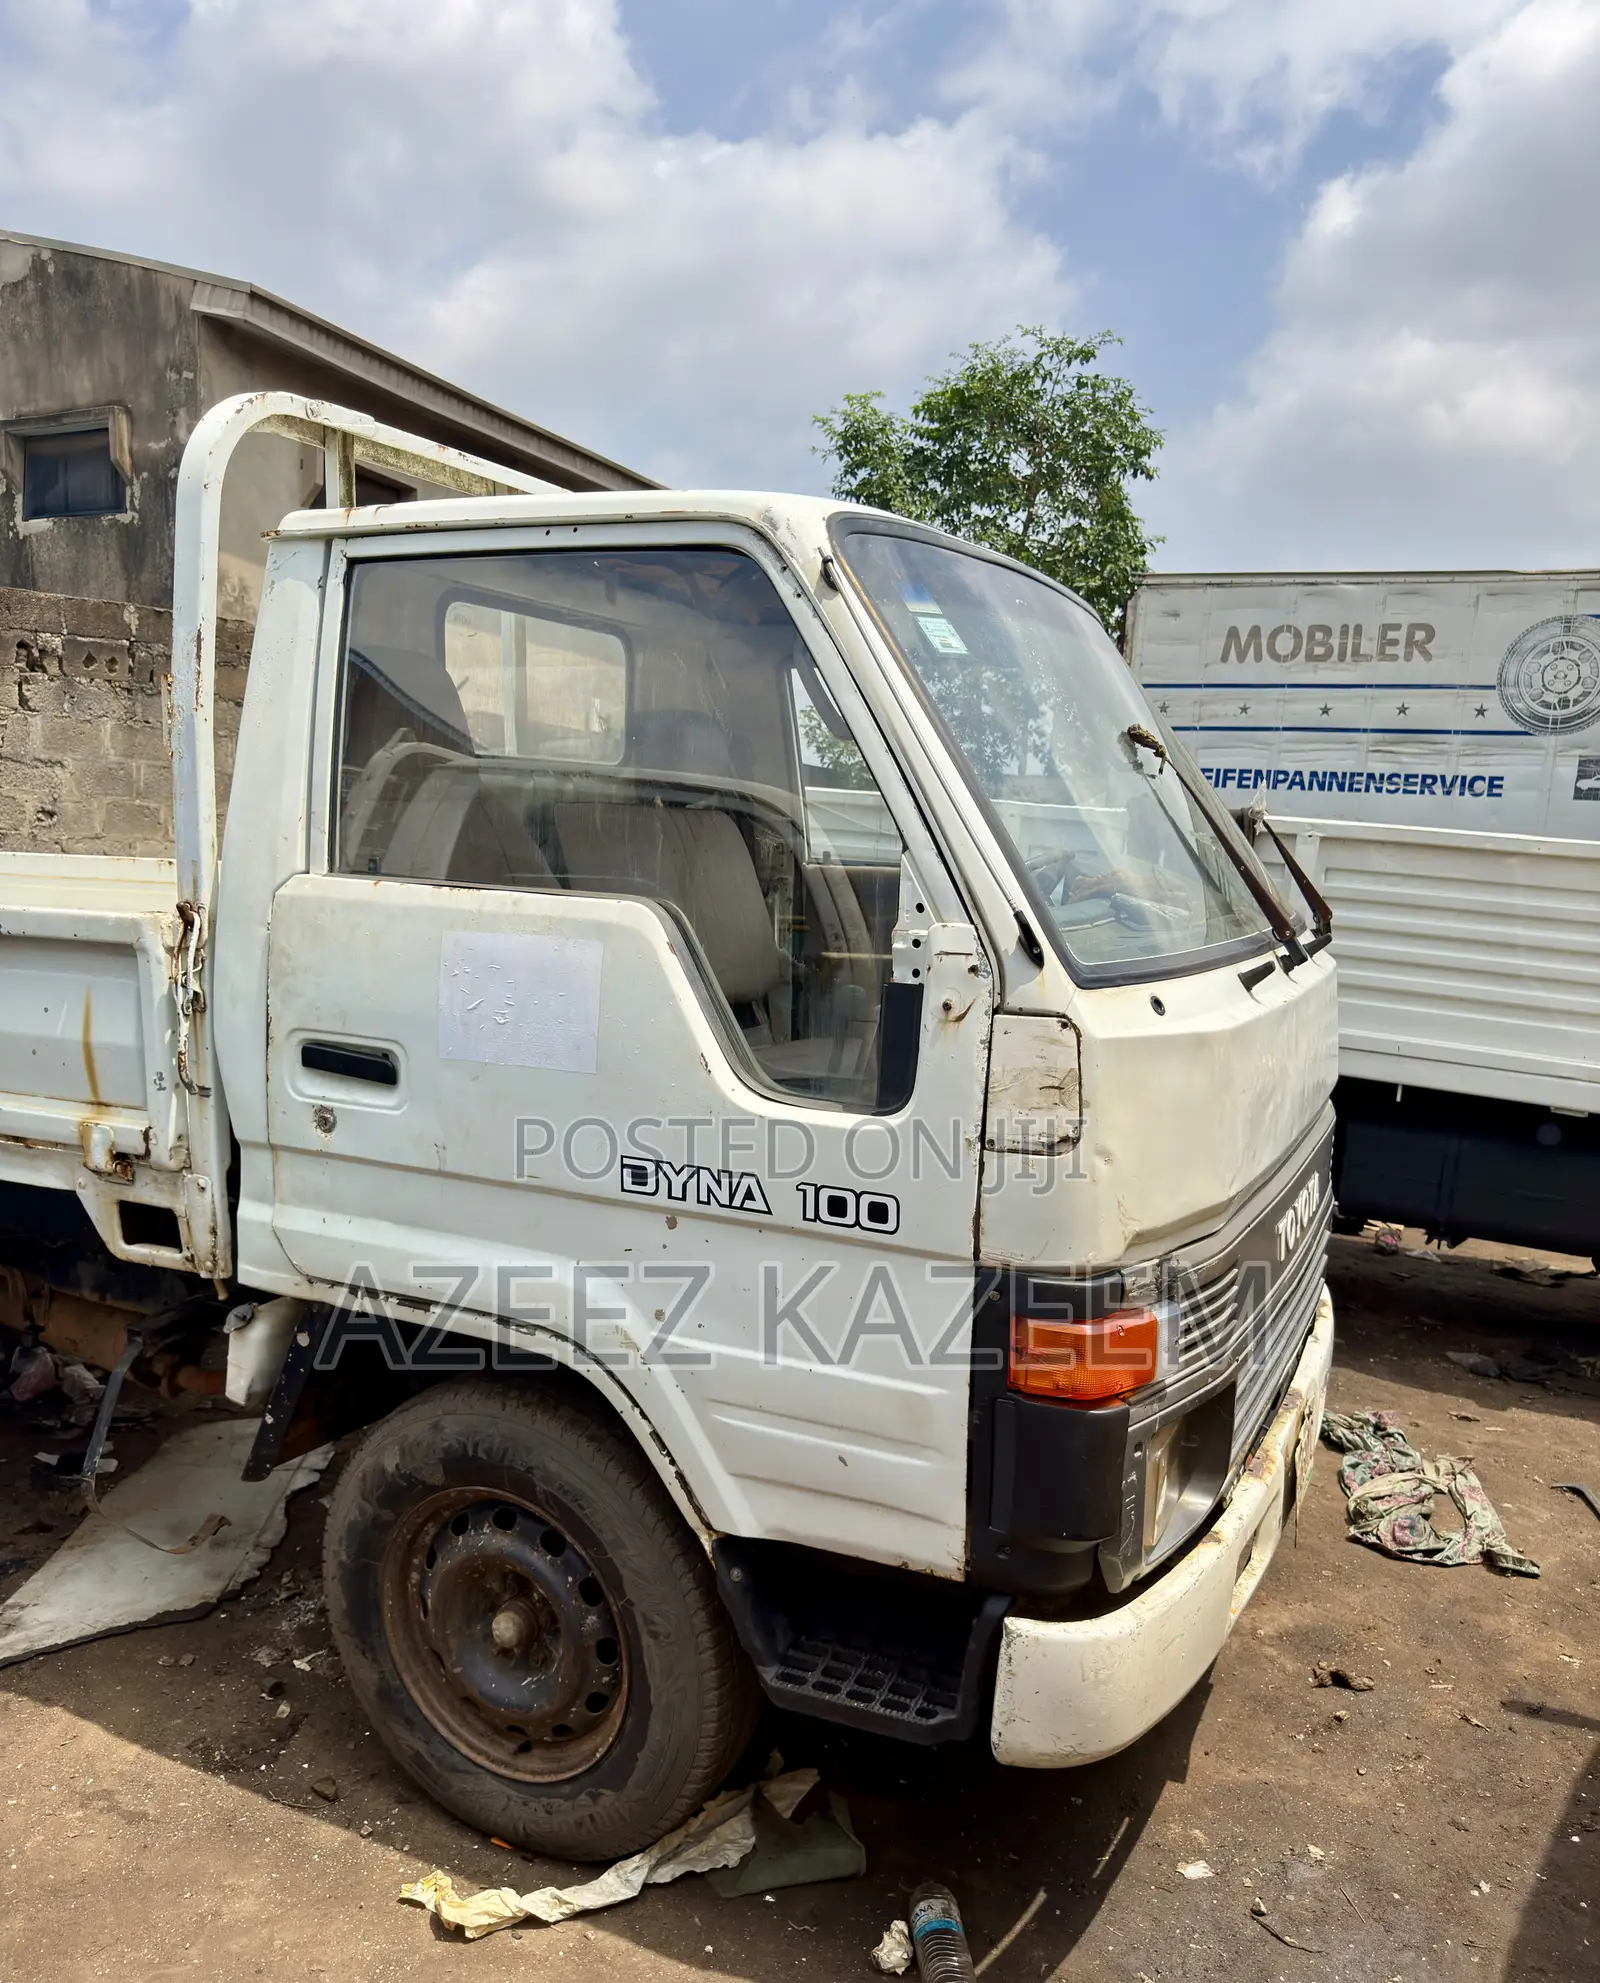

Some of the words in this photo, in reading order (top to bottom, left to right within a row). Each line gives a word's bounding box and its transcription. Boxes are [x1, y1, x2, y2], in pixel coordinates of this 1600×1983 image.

[1220, 622, 1436, 664] MOBILER
[620, 1155, 773, 1216] DYNA
[796, 1182, 900, 1235] 100
[1275, 1171, 1320, 1262] TOYOTA
